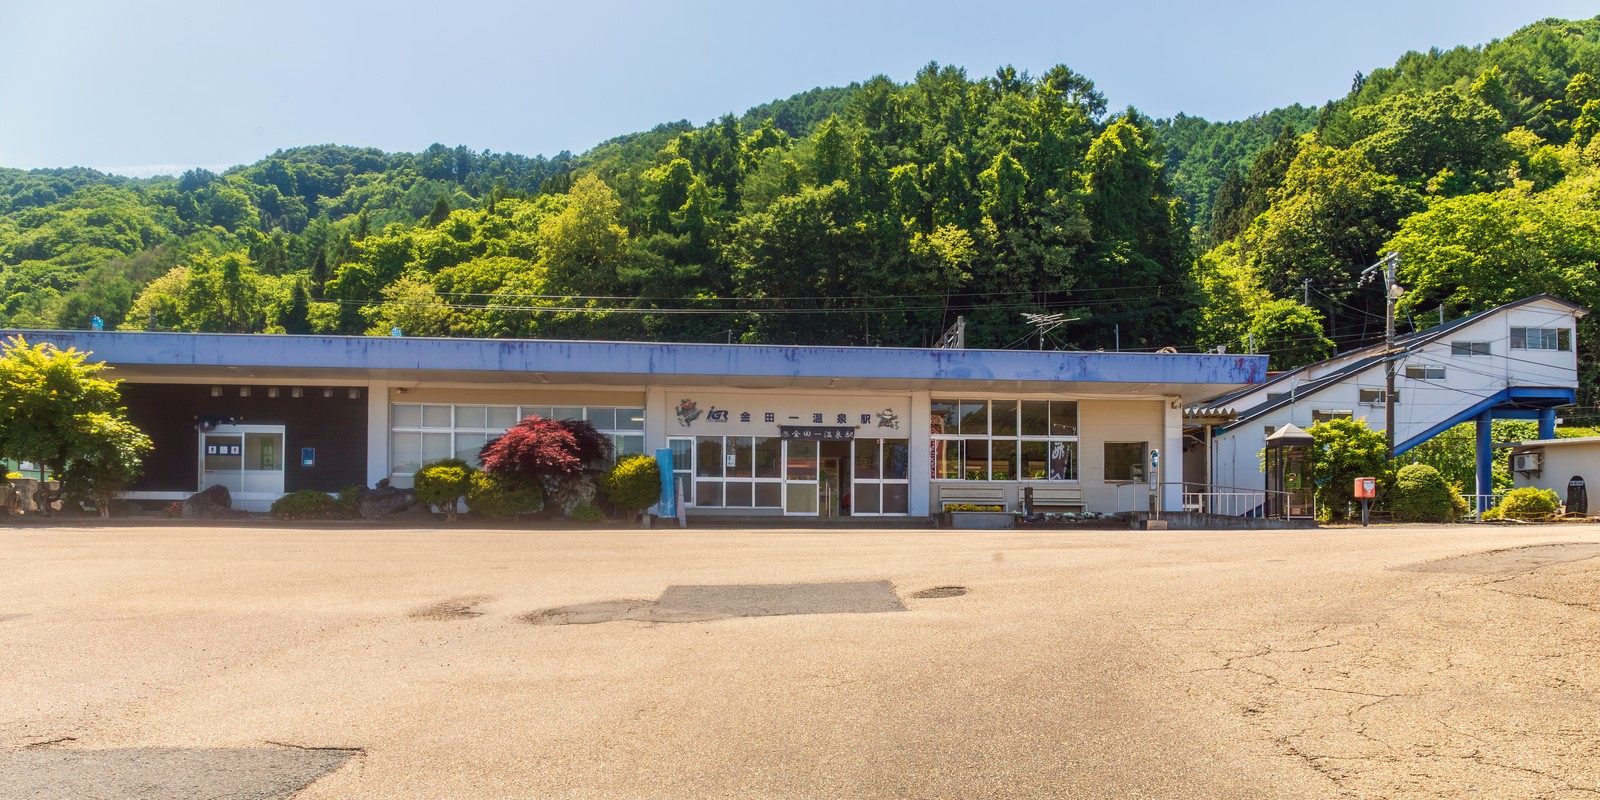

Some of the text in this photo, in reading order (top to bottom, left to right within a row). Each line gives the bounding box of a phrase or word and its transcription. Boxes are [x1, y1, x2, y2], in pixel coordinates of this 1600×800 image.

[740, 411, 871, 424] 金田一温泉駅
[791, 430, 854, 439] 金田一温泉駅
